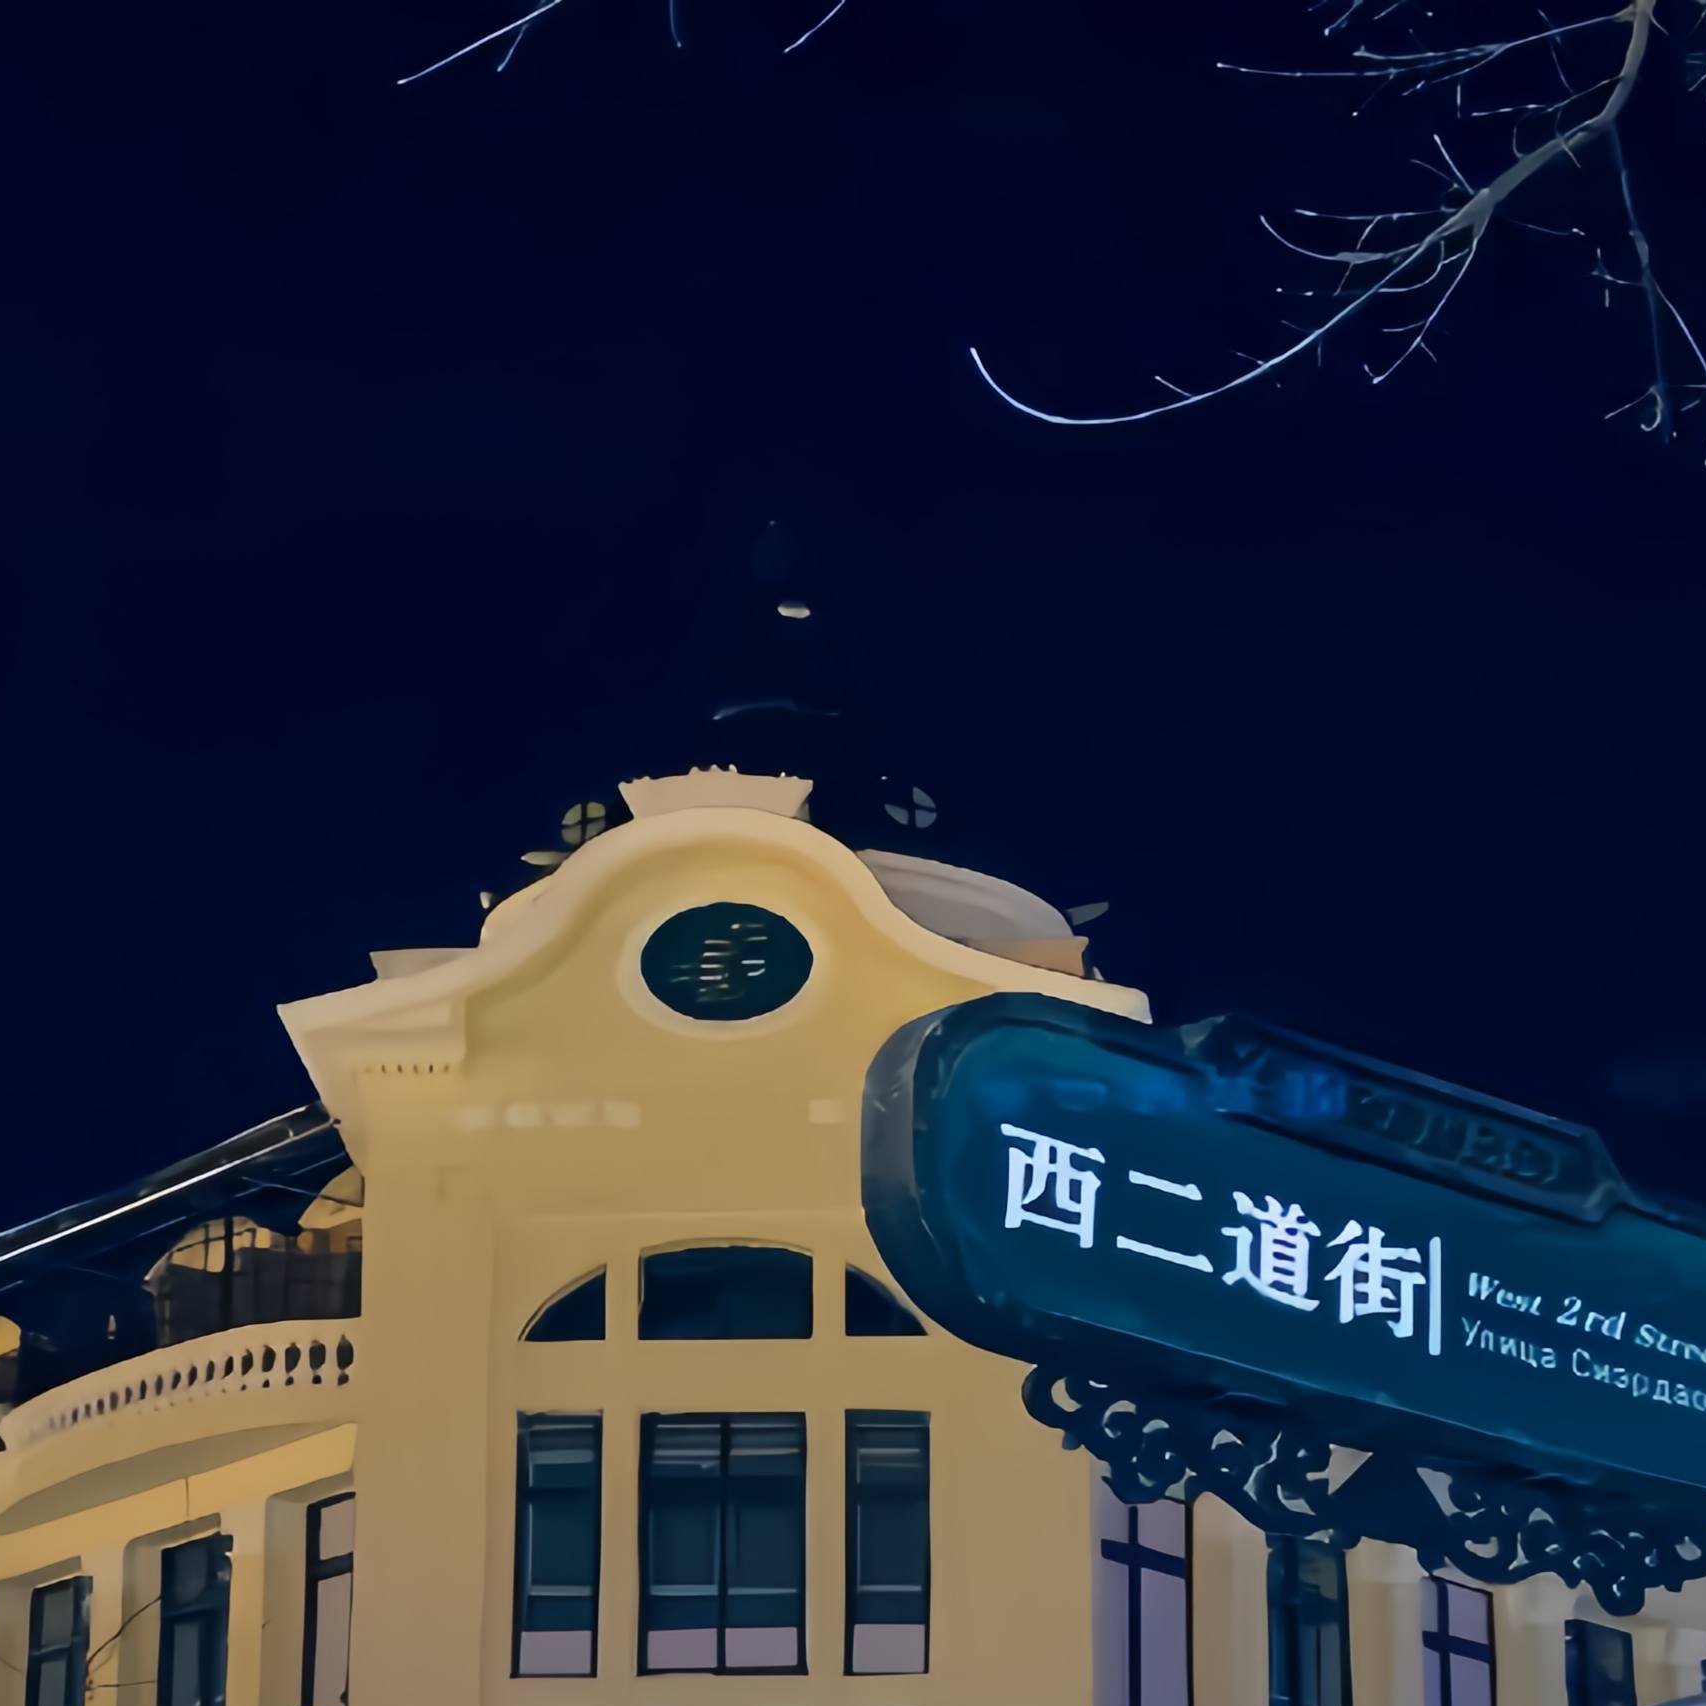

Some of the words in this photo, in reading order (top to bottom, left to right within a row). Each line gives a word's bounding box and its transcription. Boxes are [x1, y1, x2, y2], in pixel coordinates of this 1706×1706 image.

[1000, 1123, 1427, 1338] 西二道街
[1468, 1272, 1542, 1316] West
[1555, 1296, 1627, 1341] 2rd
[1461, 1316, 1557, 1369] Улица
